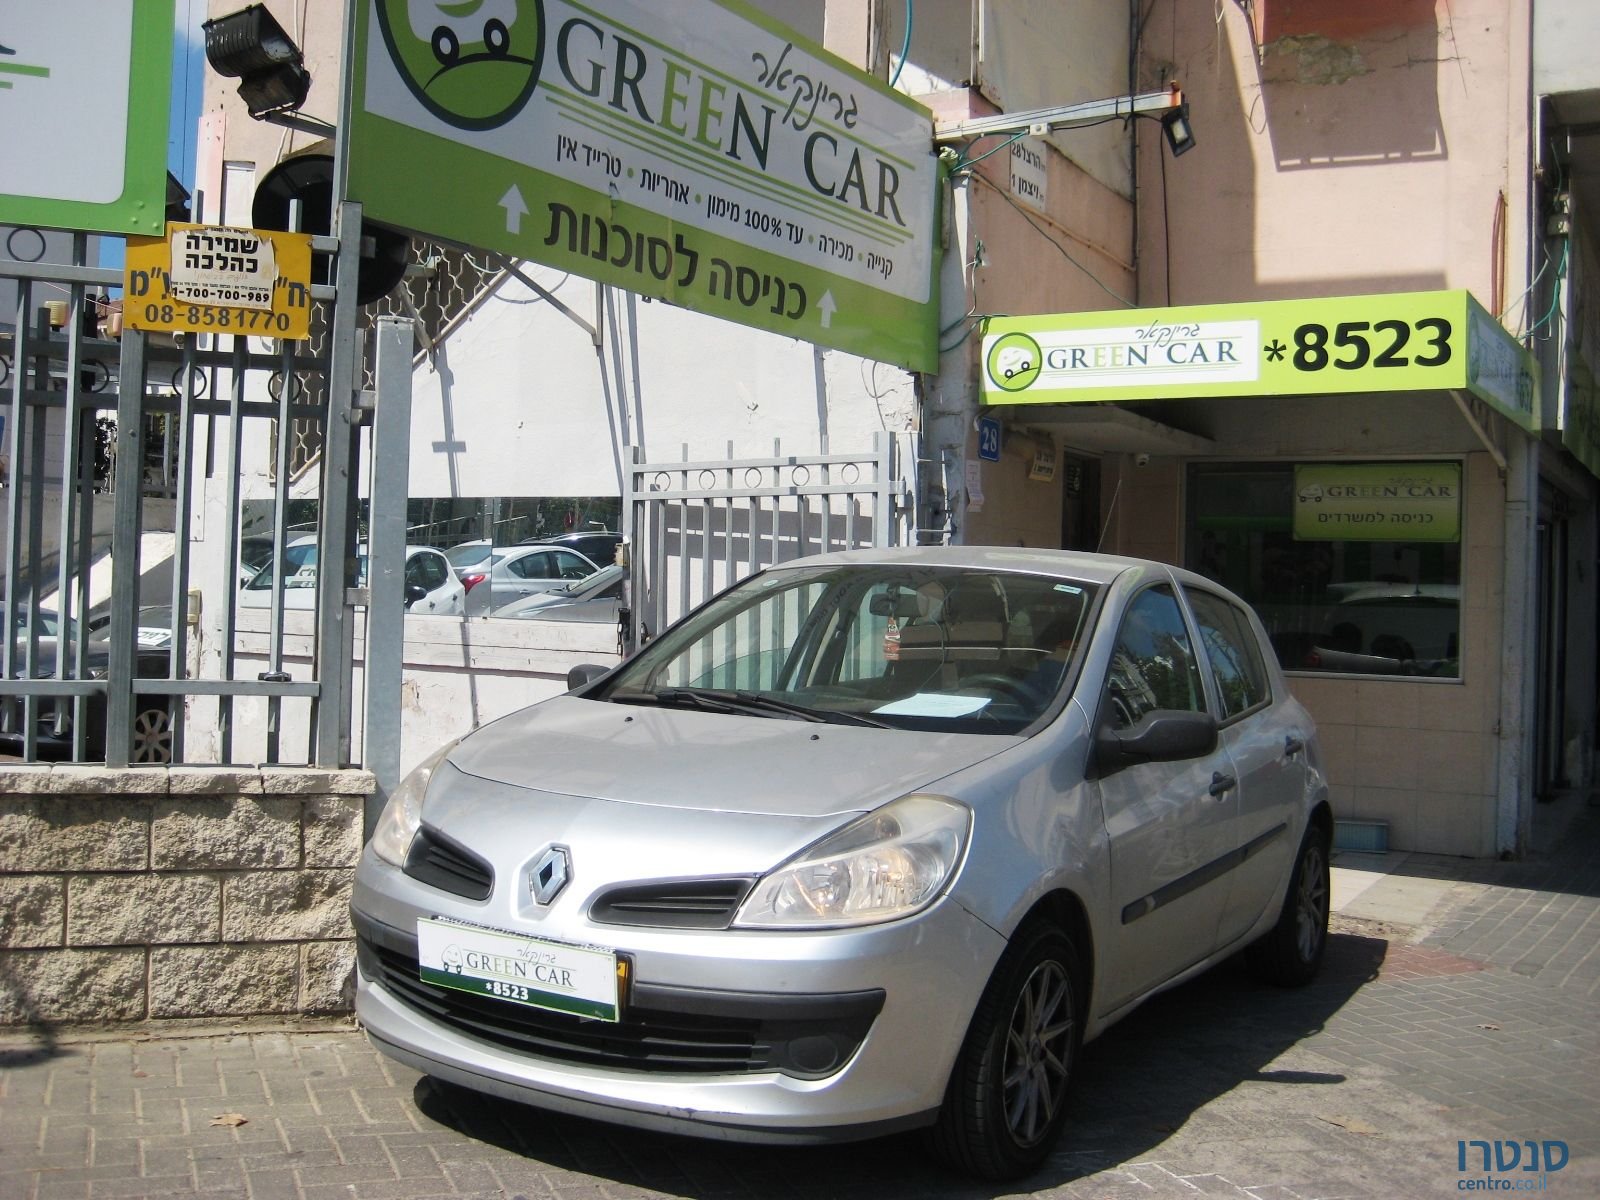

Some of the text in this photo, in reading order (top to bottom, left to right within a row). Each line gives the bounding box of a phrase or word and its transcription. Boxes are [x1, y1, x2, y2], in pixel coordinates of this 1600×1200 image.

[751, 42, 858, 131] גרינקאר
[556, 17, 907, 227] GREEN CAR
[556, 133, 893, 280] קנייה מכירה עד 100% מימון אחריות טרייד אין
[186, 234, 259, 254] שמירה
[185, 252, 258, 274] כהלכה
[543, 202, 807, 320] כניסה לסוכנות
[171, 286, 270, 303] 1-700-700-989
[145, 303, 290, 332] 08-8581770
[1134, 319, 1201, 348] גרינקאר
[1047, 344, 1149, 370] GREEN
[1166, 340, 1238, 365] CAR
[981, 426, 998, 453] 28
[1327, 485, 1451, 497] GREEN CAR
[1318, 511, 1434, 524] כניסה למשרדים
[466, 952, 574, 988] GREEN CAR
